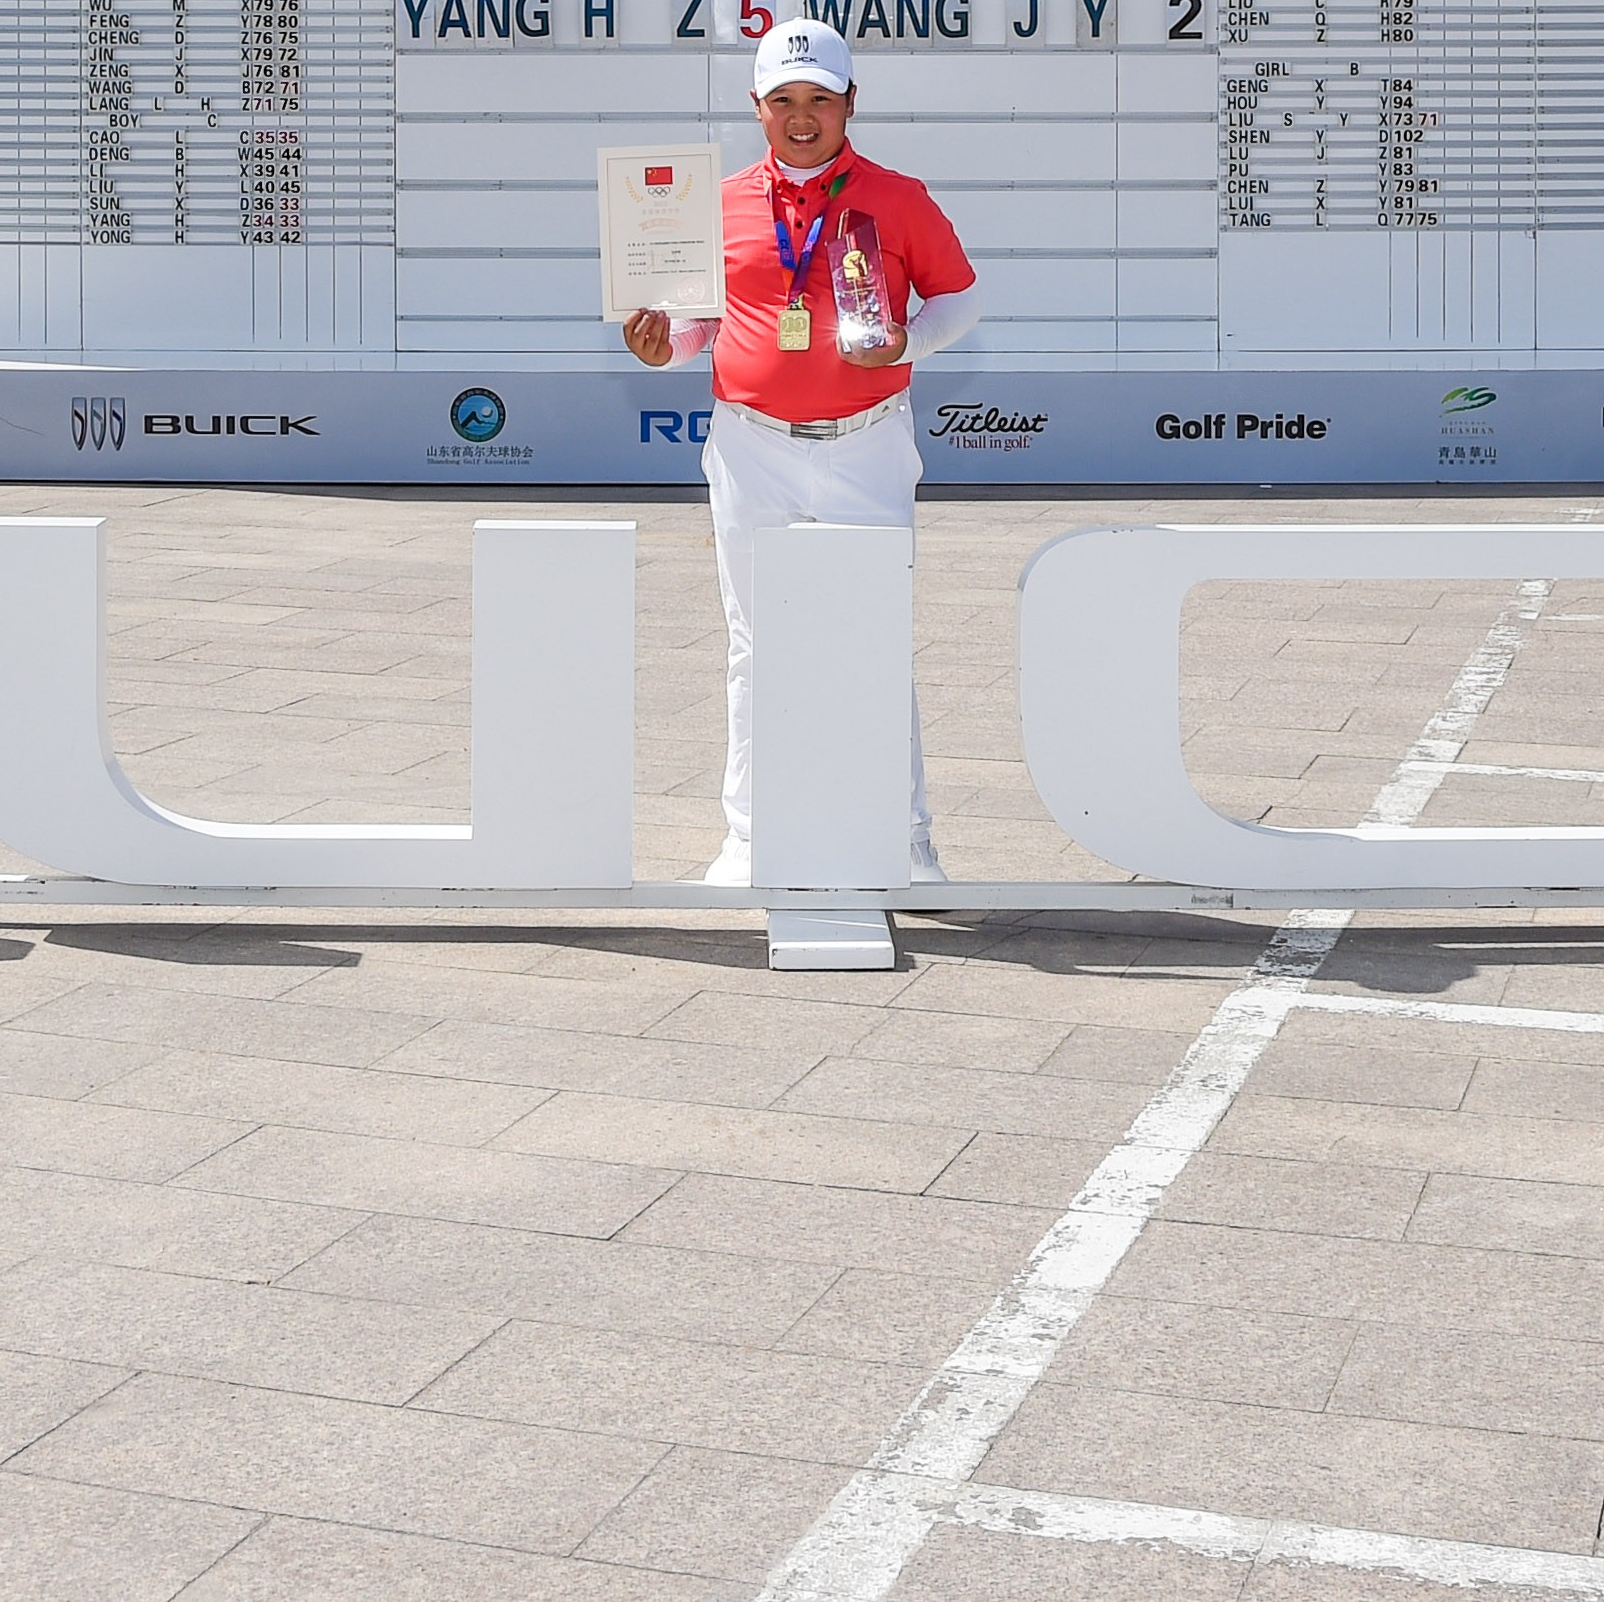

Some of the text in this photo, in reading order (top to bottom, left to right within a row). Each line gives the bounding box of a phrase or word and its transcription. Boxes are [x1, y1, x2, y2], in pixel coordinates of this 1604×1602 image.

[110, 115, 217, 128] BOY C
[1229, 113, 1439, 126] LIU S Y X 73 71
[90, 214, 300, 227] YANG H Z 34 33
[144, 415, 321, 435] BUICK
[928, 402, 1048, 437] Titleist
[1155, 413, 1327, 439] Golf Pride
[963, 435, 987, 448] ball
[989, 435, 1002, 448] in
[427, 445, 533, 458] 山东省高尔夫球协会
